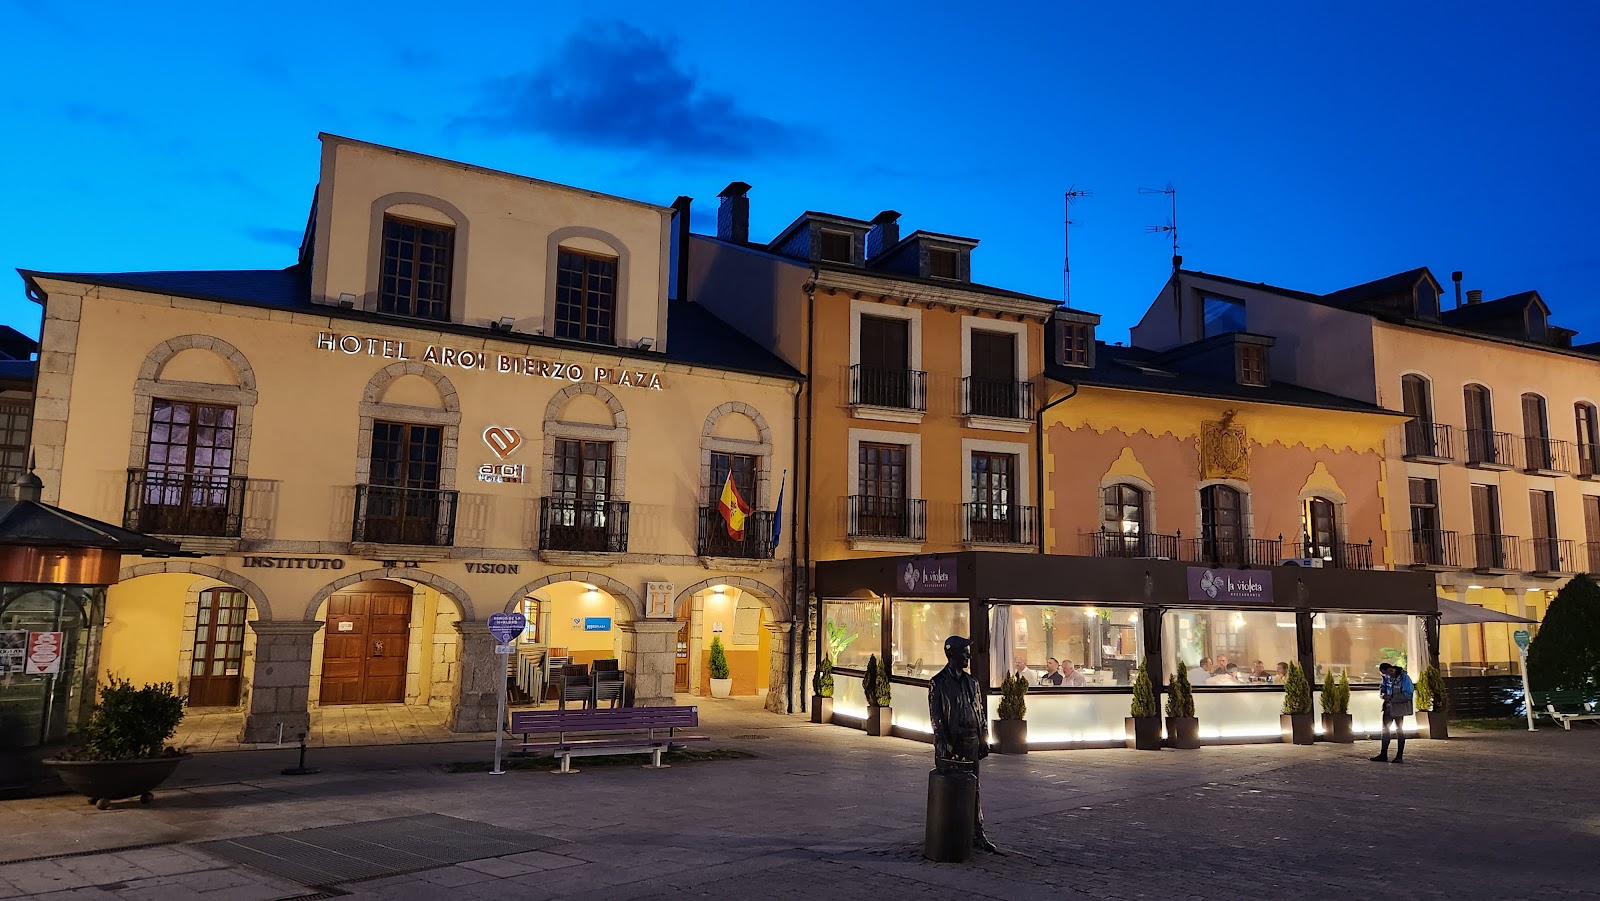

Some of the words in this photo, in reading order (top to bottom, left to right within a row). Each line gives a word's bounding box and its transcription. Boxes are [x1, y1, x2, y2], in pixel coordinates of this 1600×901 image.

[317, 331, 410, 361] HOTEL
[423, 345, 487, 371] AROI
[498, 354, 585, 382] BIERZO
[595, 366, 664, 391] PLAZA
[479, 463, 519, 478] aroi
[242, 555, 345, 570] INSTITUTO
[382, 559, 398, 568] DE
[404, 559, 420, 569] LA
[465, 562, 519, 575] VISION
[922, 566, 928, 584] la
[929, 565, 949, 584] violeta
[1227, 574, 1235, 592] la
[1236, 575, 1262, 592] violeta
